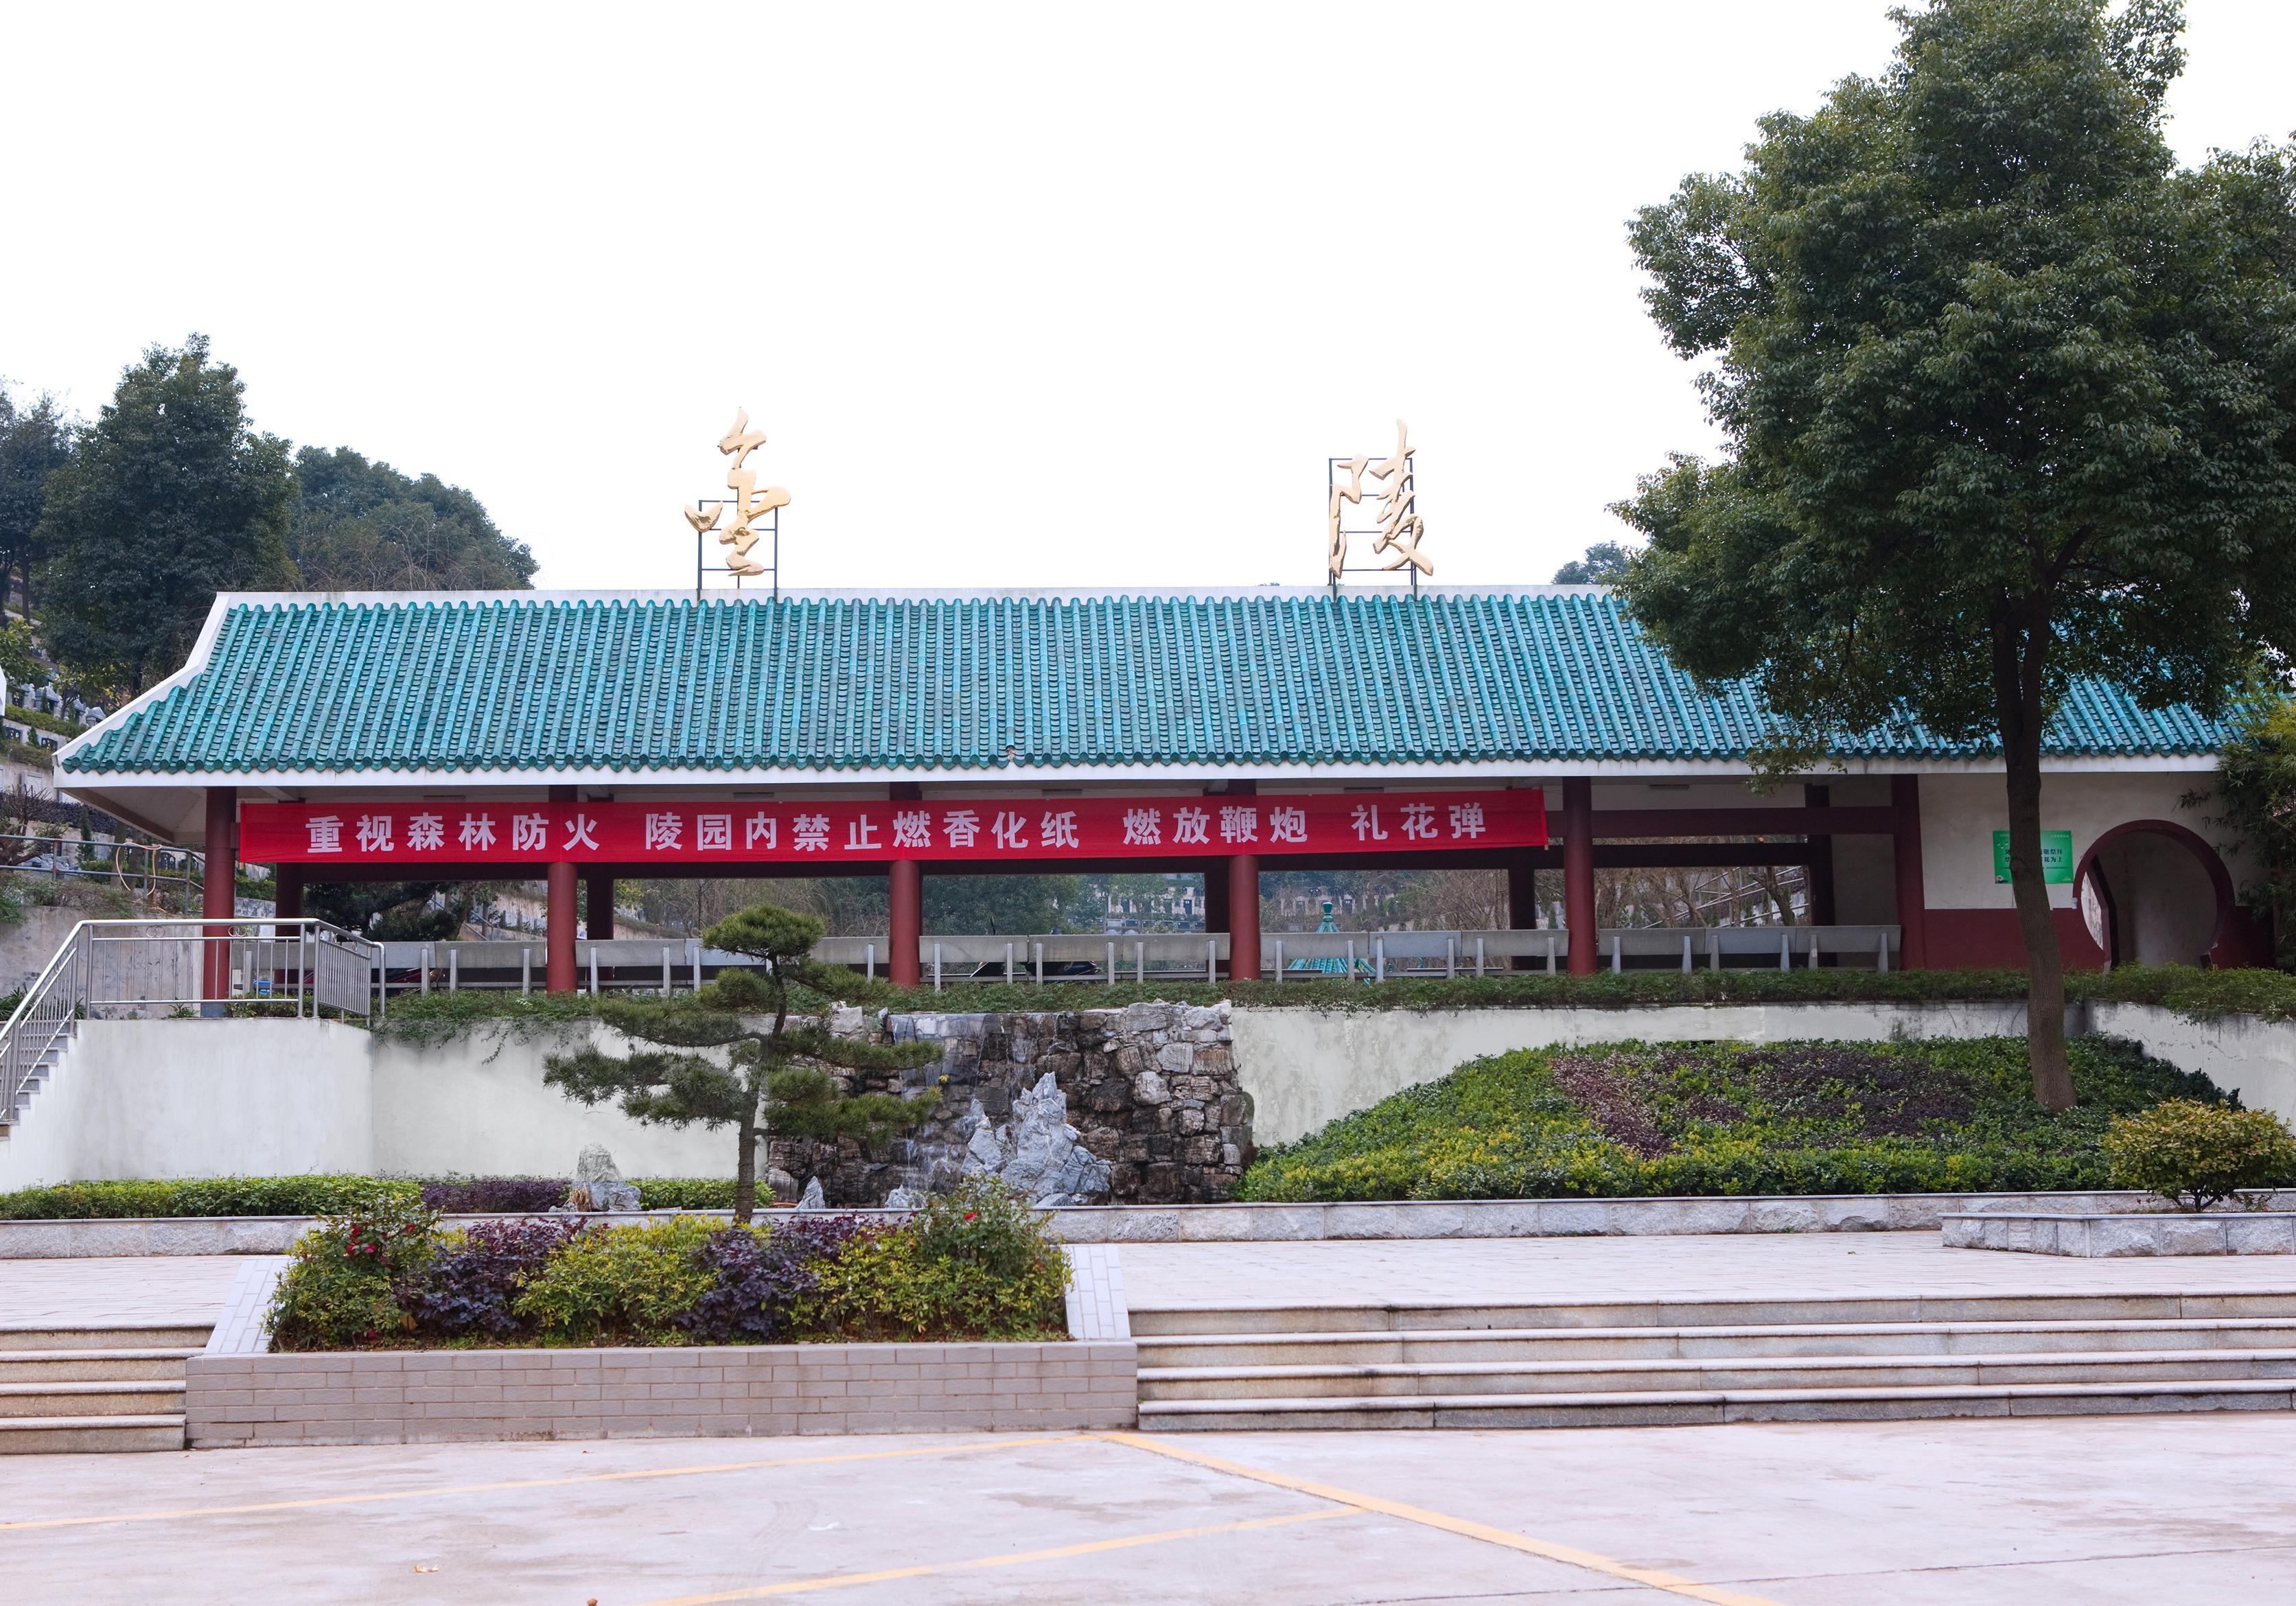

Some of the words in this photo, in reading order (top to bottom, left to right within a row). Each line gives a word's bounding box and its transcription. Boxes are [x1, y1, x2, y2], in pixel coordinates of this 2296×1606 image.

[305, 812, 600, 854] 重视森林防火
[645, 810, 1080, 852] 陵园内禁止燃香化纸
[1123, 805, 1308, 846] 燃放鞭炮
[1351, 802, 1486, 841] 礼花弹
